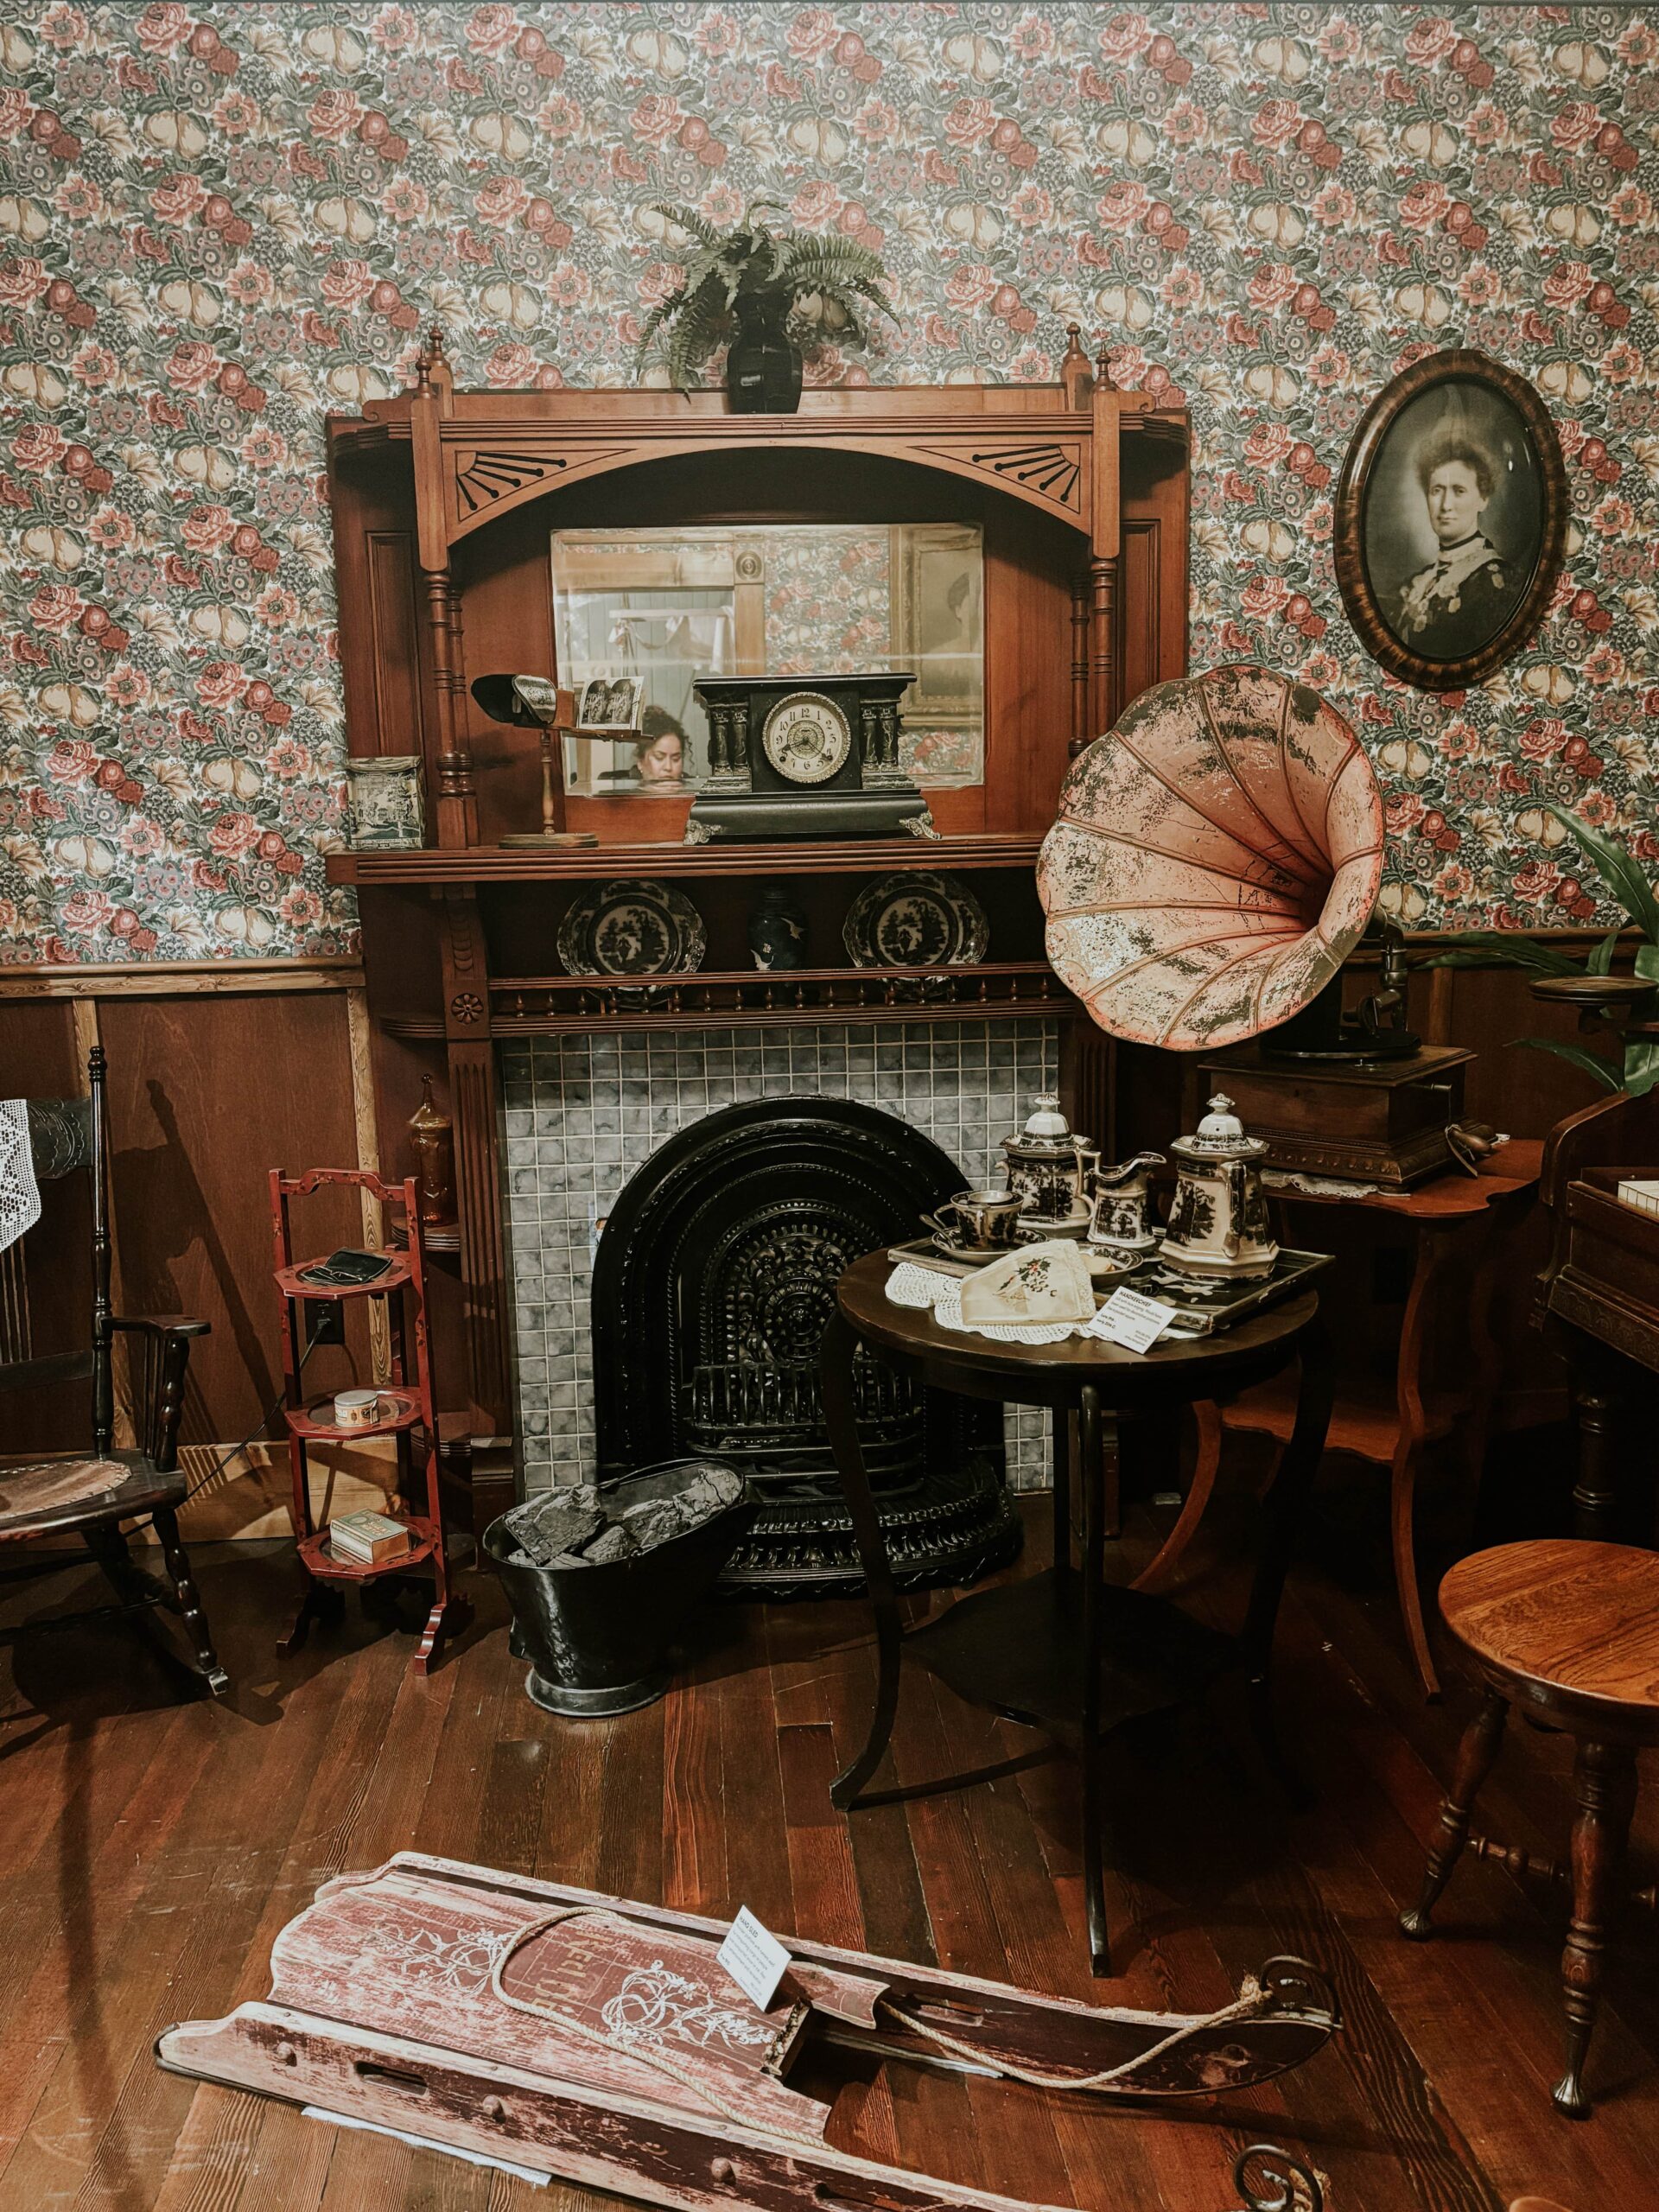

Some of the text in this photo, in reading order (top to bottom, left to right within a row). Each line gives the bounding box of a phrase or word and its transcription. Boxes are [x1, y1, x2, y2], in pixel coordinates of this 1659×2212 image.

[789, 711, 796, 721] 11
[801, 708, 810, 718] 12
[817, 710, 821, 721] 1
[779, 721, 789, 731] 10
[825, 719, 832, 730] 2
[776, 735, 783, 744] 9
[829, 733, 836, 743] 3
[791, 758, 797, 768] 7
[804, 760, 810, 770] 6
[1120, 1291, 1152, 1307] HANDKERCHIEF
[740, 1916, 759, 1938] HAND SLED
